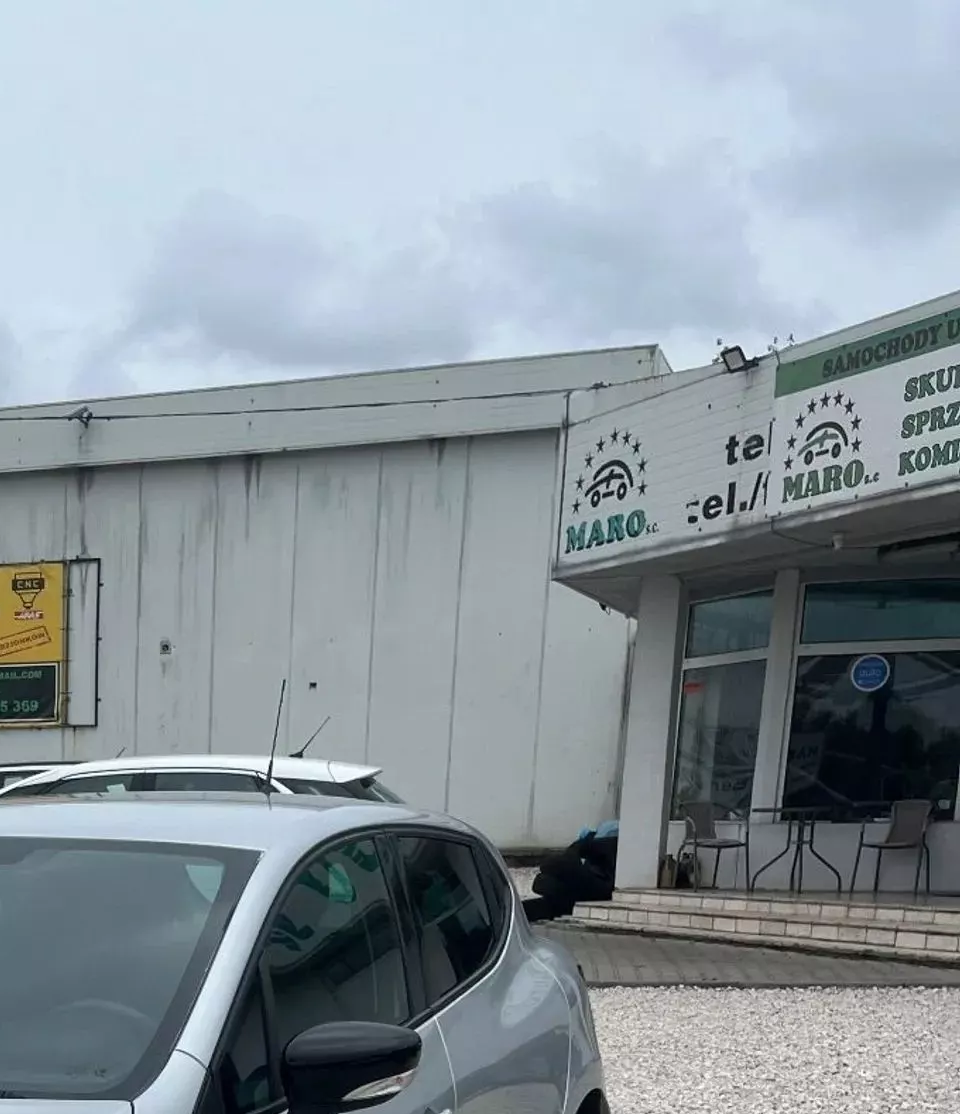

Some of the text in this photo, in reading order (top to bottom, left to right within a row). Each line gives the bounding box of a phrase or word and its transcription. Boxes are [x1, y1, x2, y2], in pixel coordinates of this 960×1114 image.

[821, 322, 943, 379] SAMOCHODY
[781, 458, 864, 503] MARO
[564, 508, 646, 554] MARO
[16, 579, 41, 589] CNC
